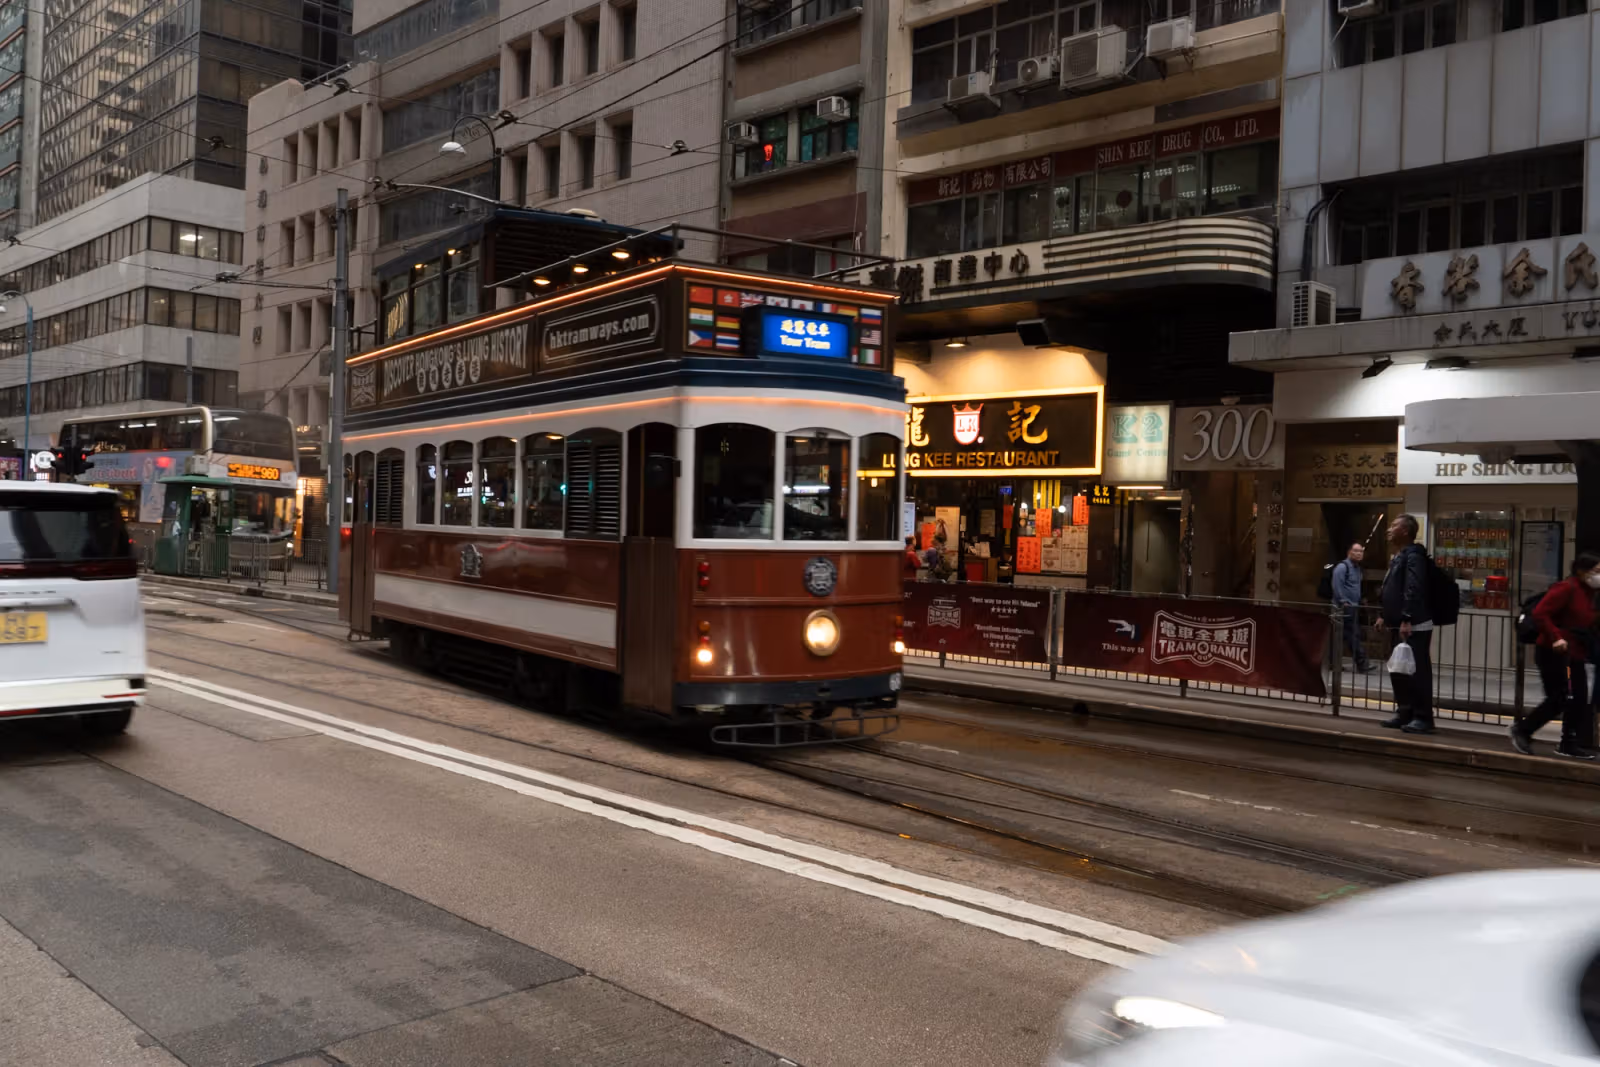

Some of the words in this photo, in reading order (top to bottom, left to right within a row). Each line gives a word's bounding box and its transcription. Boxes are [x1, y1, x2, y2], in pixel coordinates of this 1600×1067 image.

[1098, 144, 1124, 164] SHIN
[1129, 139, 1152, 159] KEE
[1162, 131, 1191, 152] DRUG
[1234, 118, 1260, 138] LTD.
[1005, 157, 1052, 184] 有限公司
[549, 313, 649, 350] hktramways.com
[1562, 310, 1600, 331] YU
[384, 355, 415, 397] DISCOVER
[462, 336, 489, 362] LIVING
[490, 324, 528, 369] HISTORY
[1006, 401, 1049, 444] 記
[1182, 407, 1275, 462] 300
[924, 452, 952, 468] KEE
[956, 450, 1059, 468] RESTAURANT
[1436, 463, 1467, 477] HIP
[1472, 462, 1534, 477] SHING
[1352, 472, 1397, 488] HOUSE
[1159, 620, 1249, 645] 電車全景遊
[1102, 642, 1119, 650] This
[1120, 645, 1136, 653] way
[1136, 645, 1145, 653] to
[1158, 639, 1249, 665] TRAMORAMIC
